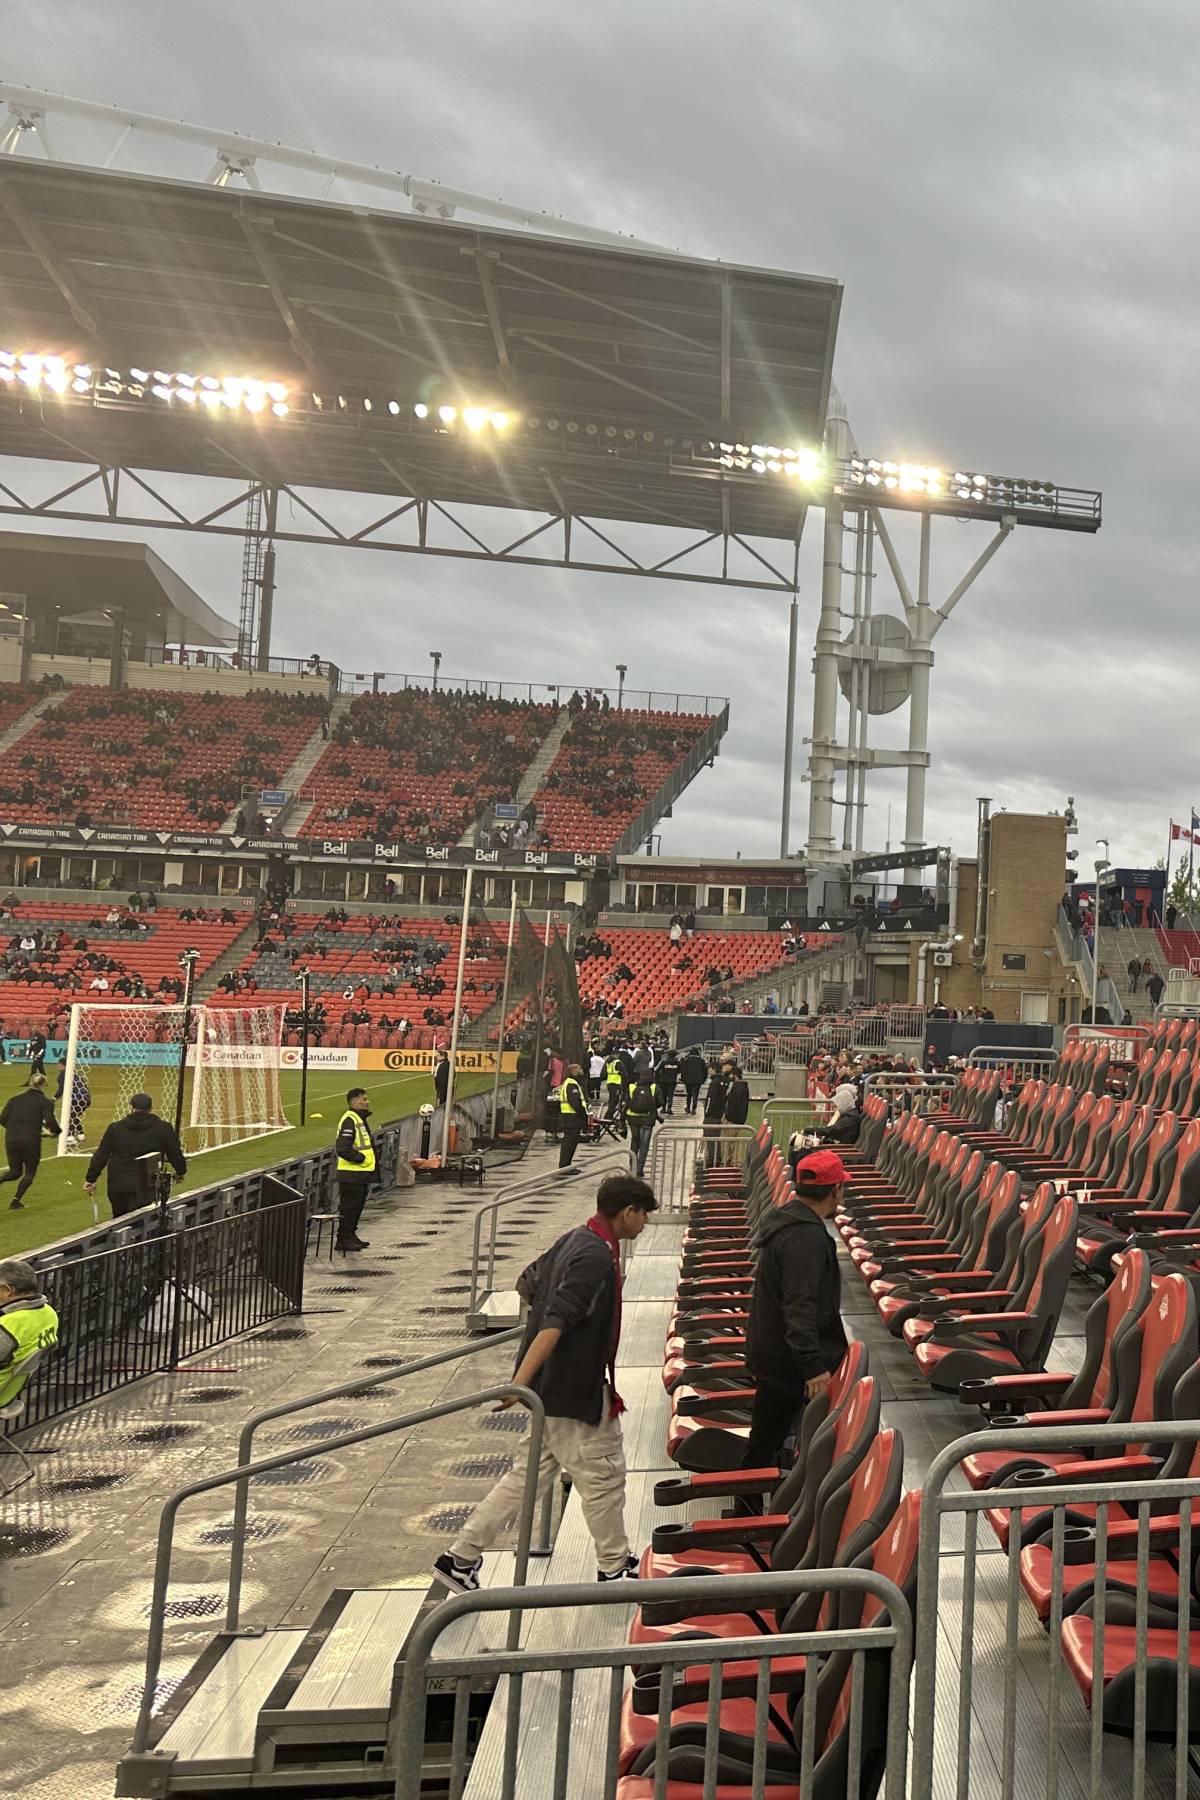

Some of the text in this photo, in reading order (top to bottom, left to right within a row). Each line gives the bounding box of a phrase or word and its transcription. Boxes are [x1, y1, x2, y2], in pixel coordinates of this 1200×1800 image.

[18, 827, 71, 838] CANADIAN TIRE
[97, 832, 148, 842] CANADIAN TIRE
[173, 836, 208, 844] CANADIAN
[248, 840, 299, 850] CANADIAN TIRE
[323, 842, 348, 855] Bell
[375, 845, 399, 857] Bell
[426, 847, 449, 860] Bell
[475, 849, 499, 862] Bell
[525, 852, 548, 865] Bell
[574, 855, 597, 866] Bell
